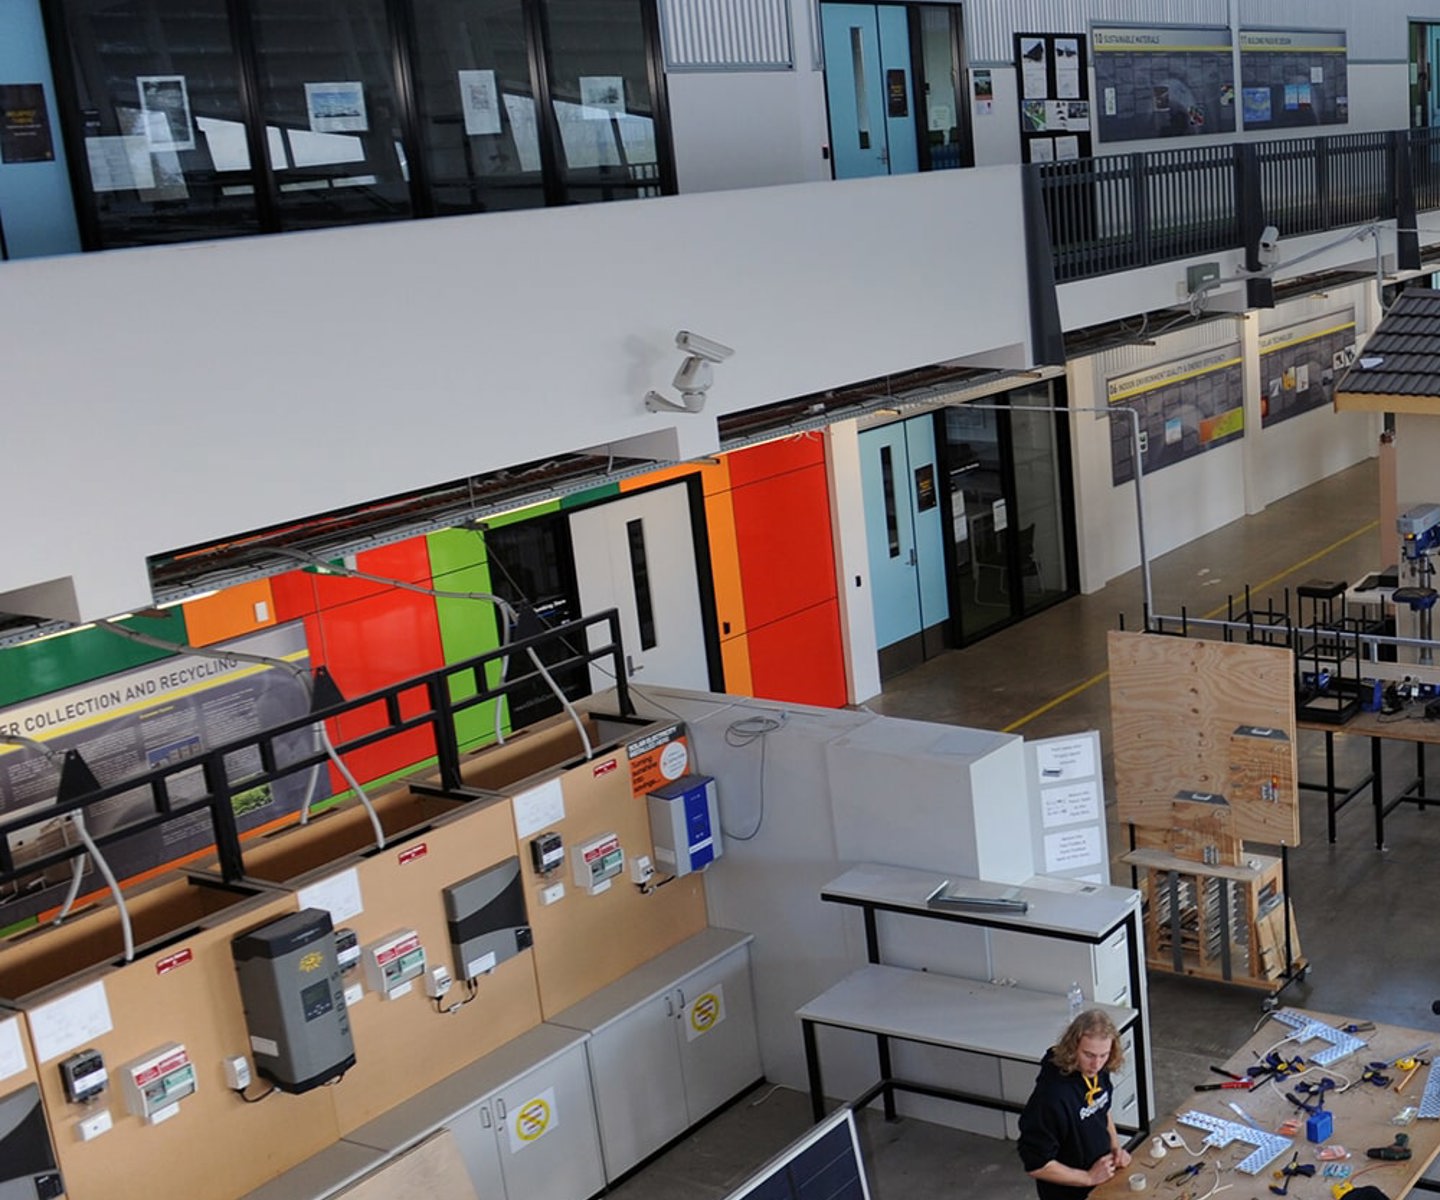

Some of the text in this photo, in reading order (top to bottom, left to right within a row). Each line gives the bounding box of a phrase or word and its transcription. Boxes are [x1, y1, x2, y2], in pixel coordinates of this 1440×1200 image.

[24, 691, 121, 731] COLLECTION
[125, 681, 157, 702] AND
[161, 655, 238, 690] RECYCLING
